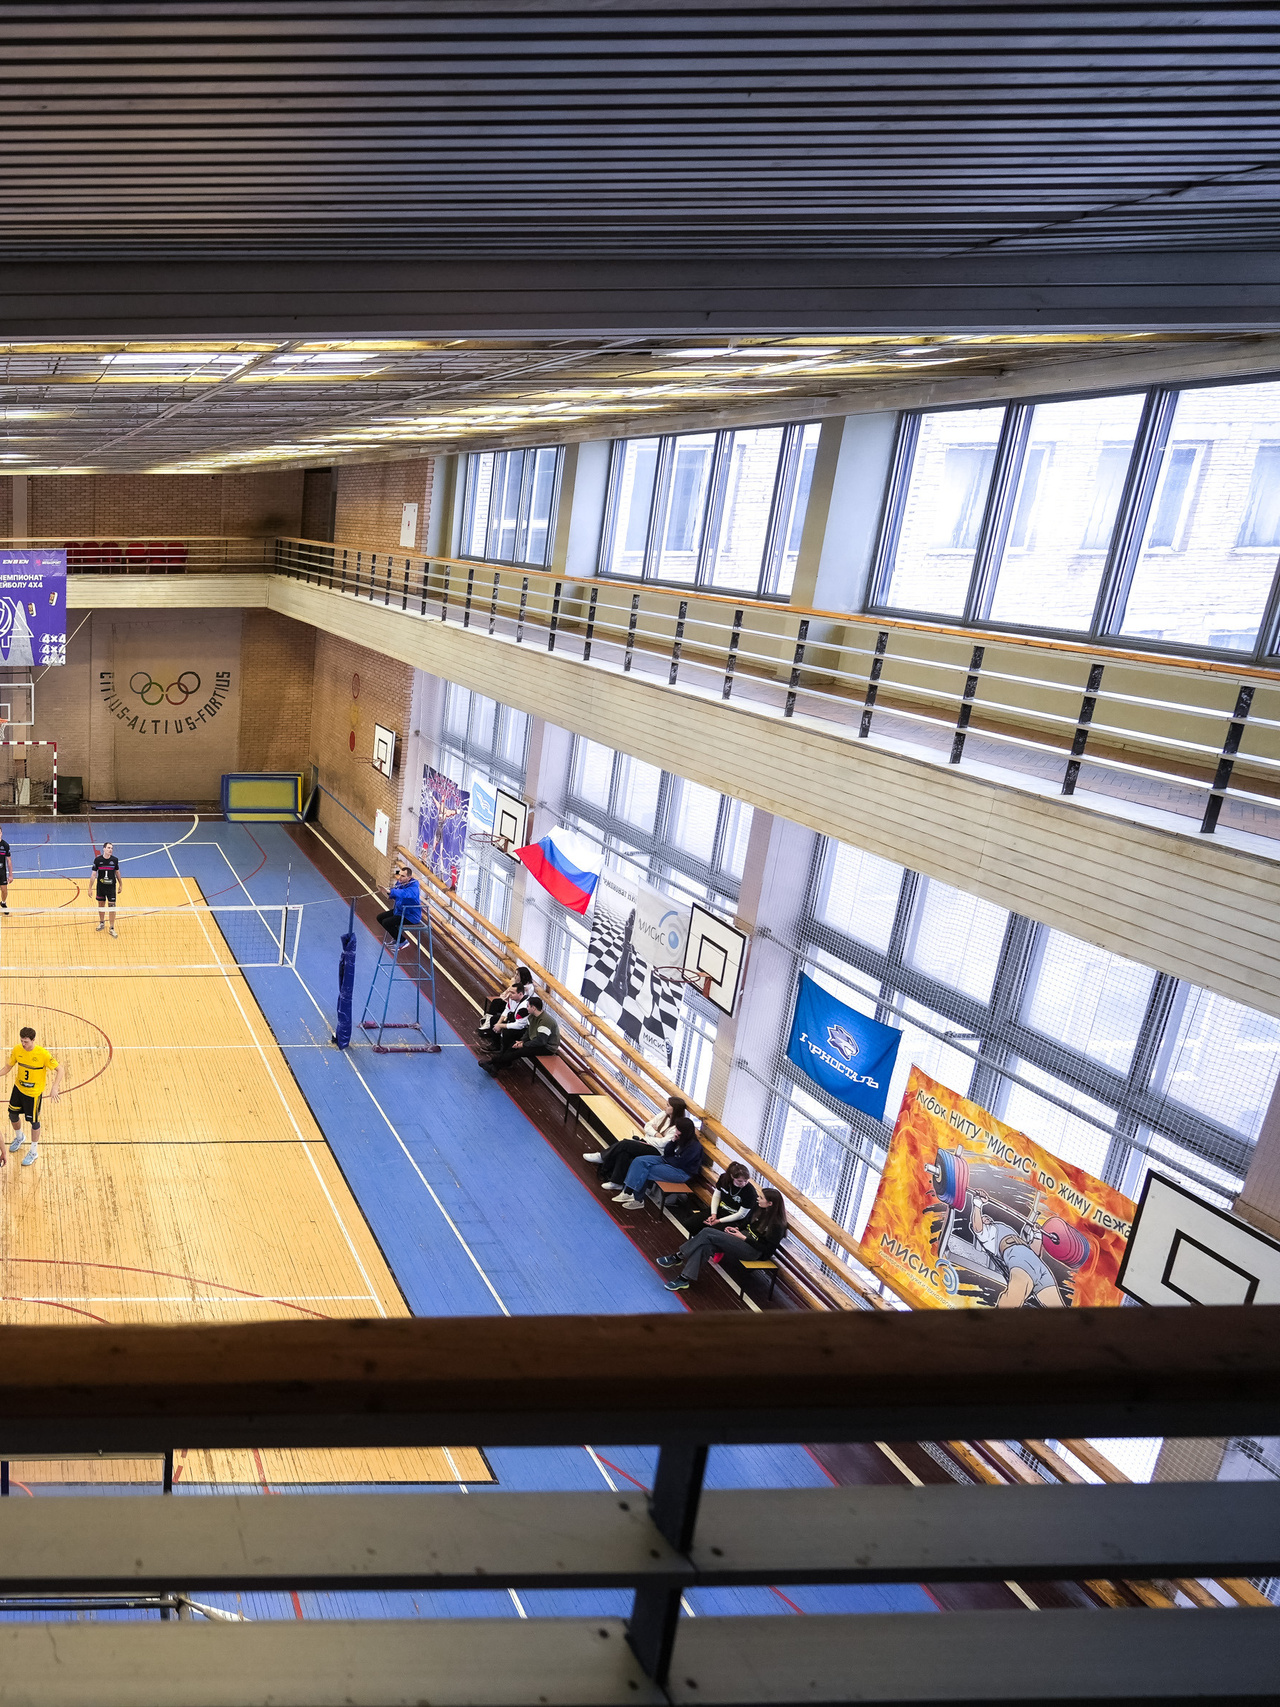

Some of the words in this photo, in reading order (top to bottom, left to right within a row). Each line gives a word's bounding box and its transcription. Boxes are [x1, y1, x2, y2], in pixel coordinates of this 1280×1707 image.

[24, 1070, 30, 1081] 3
[915, 1089, 947, 1119] Кубок
[949, 1112, 981, 1139] НИТУ
[1037, 1169, 1056, 1191] по
[1059, 1182, 1091, 1217] жиму
